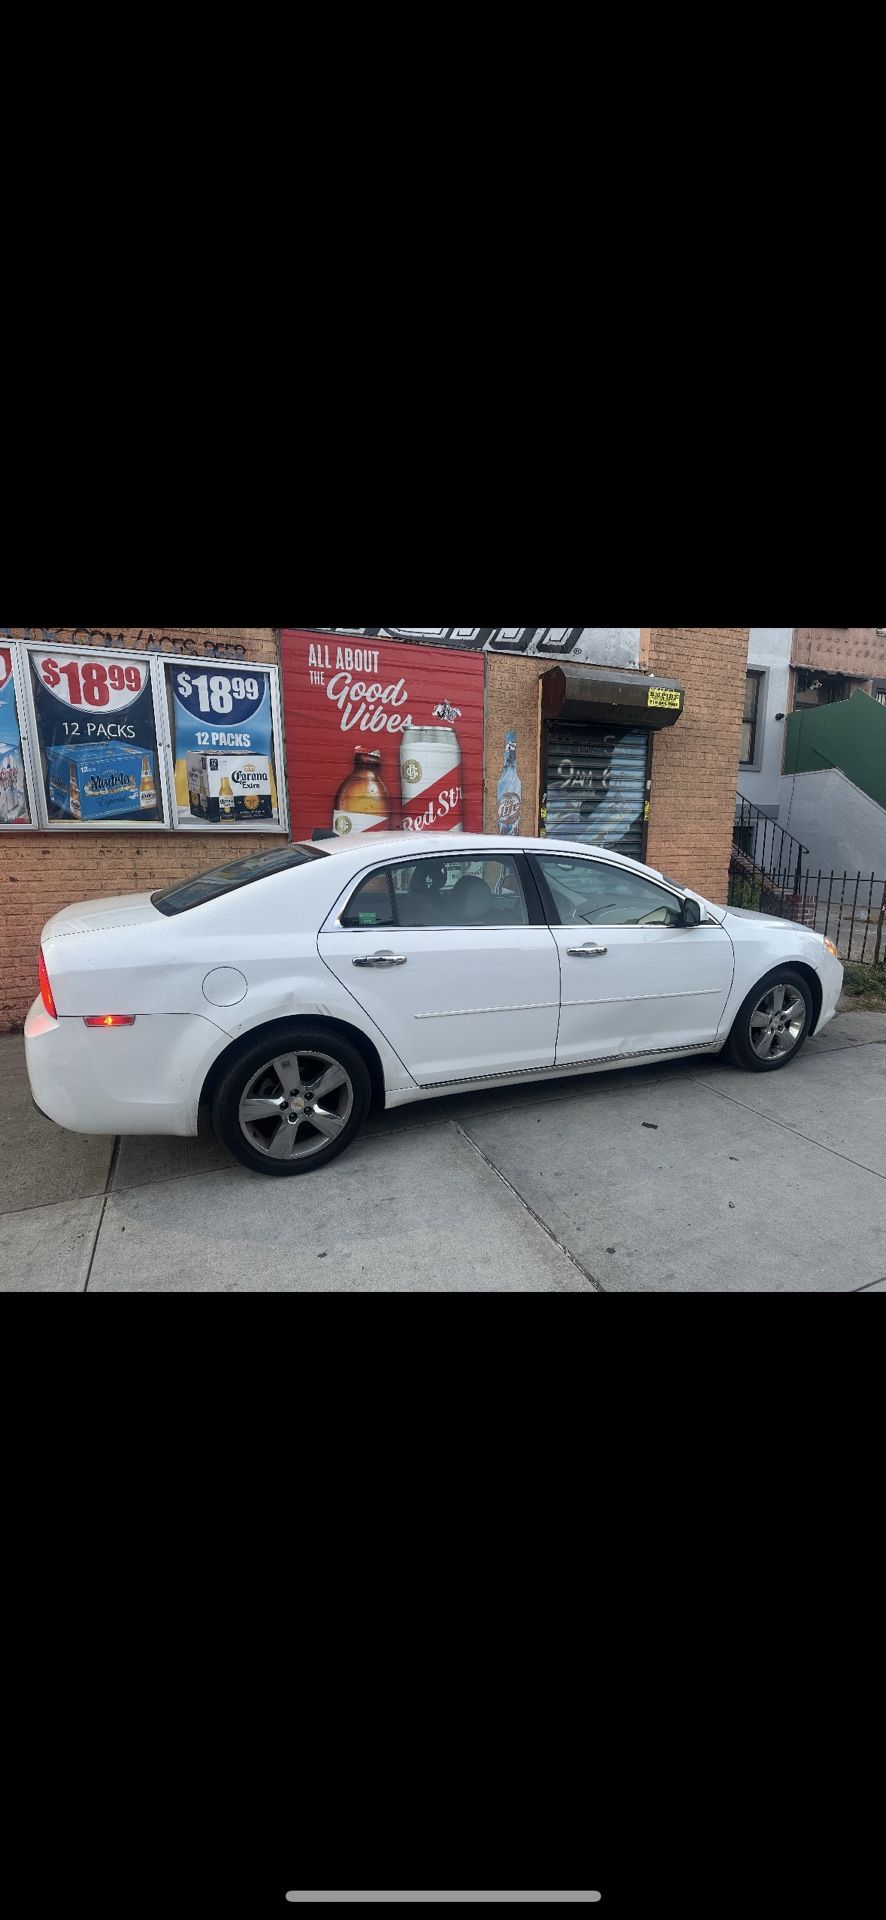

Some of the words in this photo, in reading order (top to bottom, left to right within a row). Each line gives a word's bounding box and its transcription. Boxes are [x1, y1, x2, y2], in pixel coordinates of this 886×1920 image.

[308, 643, 332, 669] ALL
[335, 647, 380, 673] ABOUT
[309, 670, 325, 685] THE
[326, 672, 408, 709] Good
[339, 702, 415, 733] Vibes
[62, 722, 80, 736] 12
[86, 722, 136, 739] PACKS
[195, 731, 210, 746] 12
[211, 732, 252, 748] PACKS
[231, 770, 268, 784] Corona
